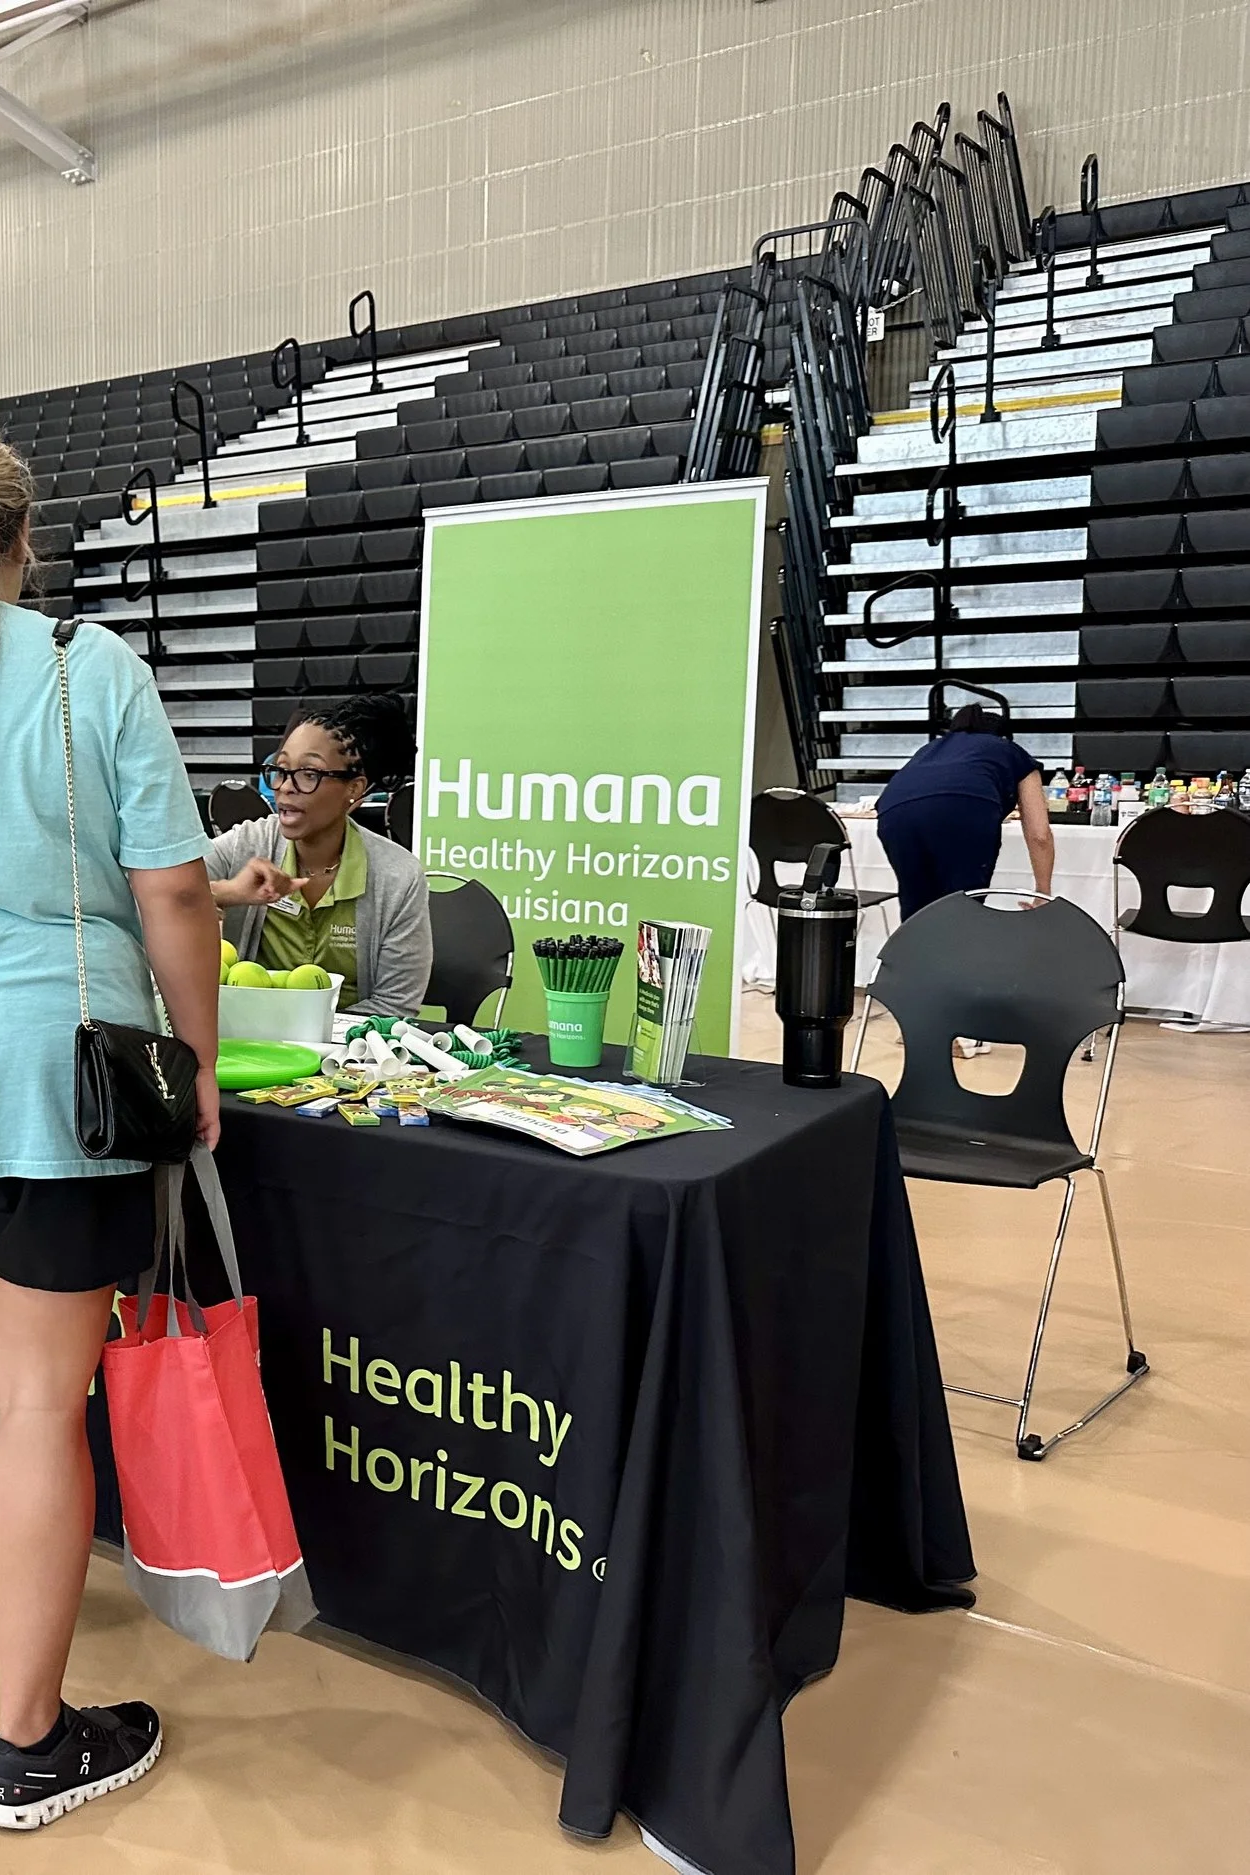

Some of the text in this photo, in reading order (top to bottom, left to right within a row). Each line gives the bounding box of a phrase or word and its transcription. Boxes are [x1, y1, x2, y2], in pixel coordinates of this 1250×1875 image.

[428, 758, 721, 827] Humana
[425, 836, 731, 883] Healthy Horizons
[503, 888, 628, 928] uisiana
[496, 1109, 569, 1135] Humana
[323, 1327, 573, 1467] Healthy
[325, 1415, 585, 1571] Horizons
